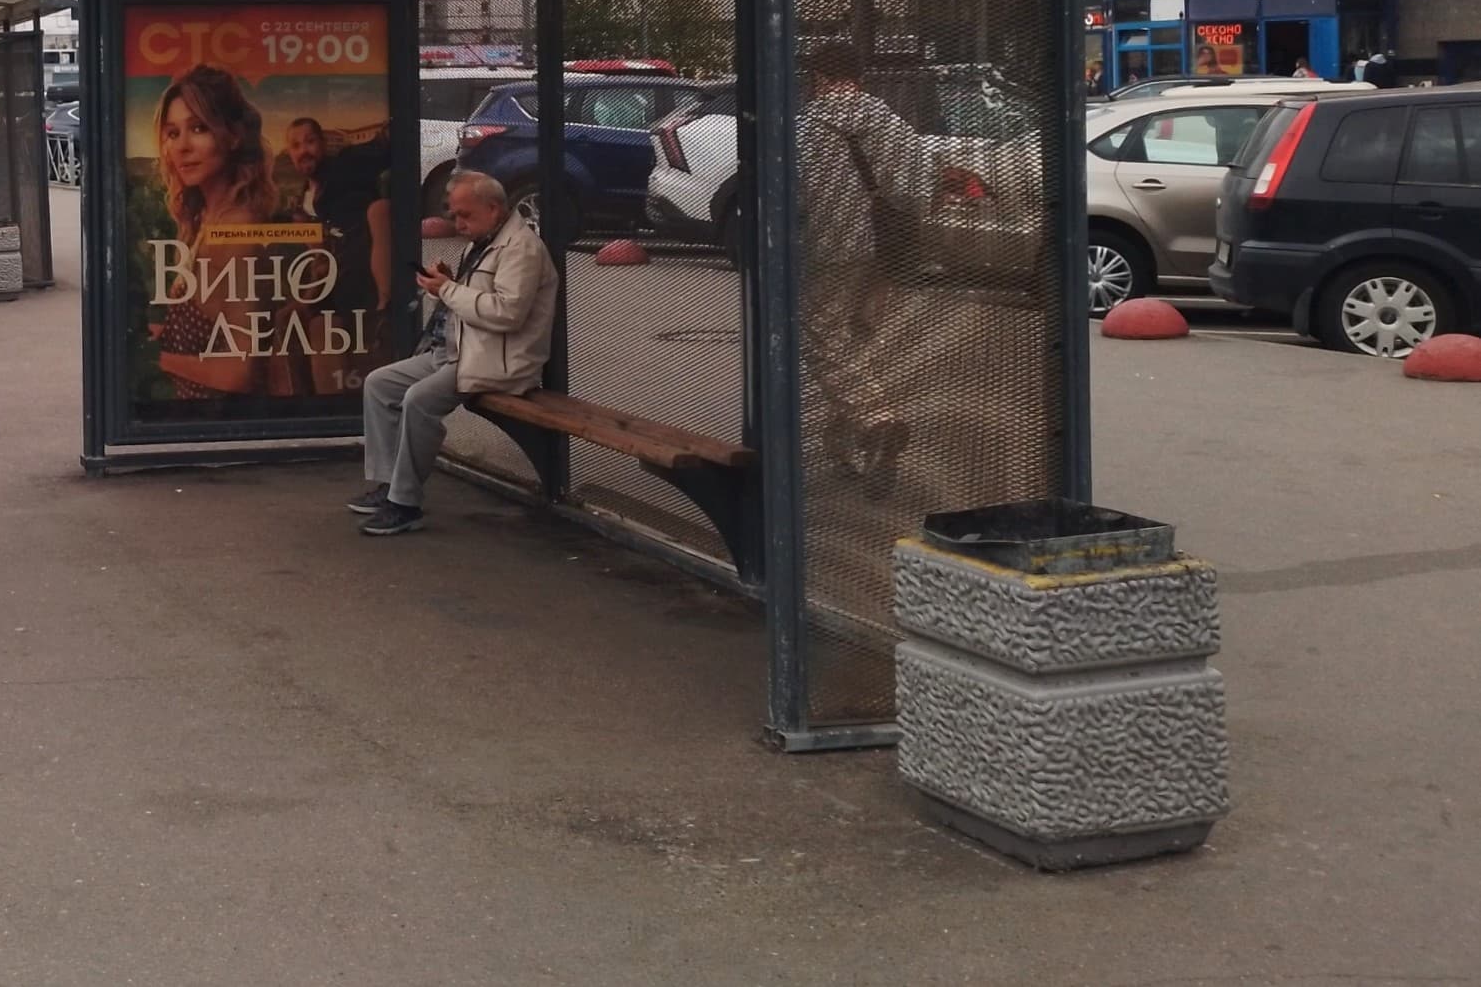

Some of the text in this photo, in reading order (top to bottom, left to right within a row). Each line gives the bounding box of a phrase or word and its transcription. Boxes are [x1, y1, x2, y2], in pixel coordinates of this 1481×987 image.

[295, 21, 370, 33] СЕНТЯБРЯ
[138, 22, 252, 64] СТС
[262, 34, 369, 64] 19:00
